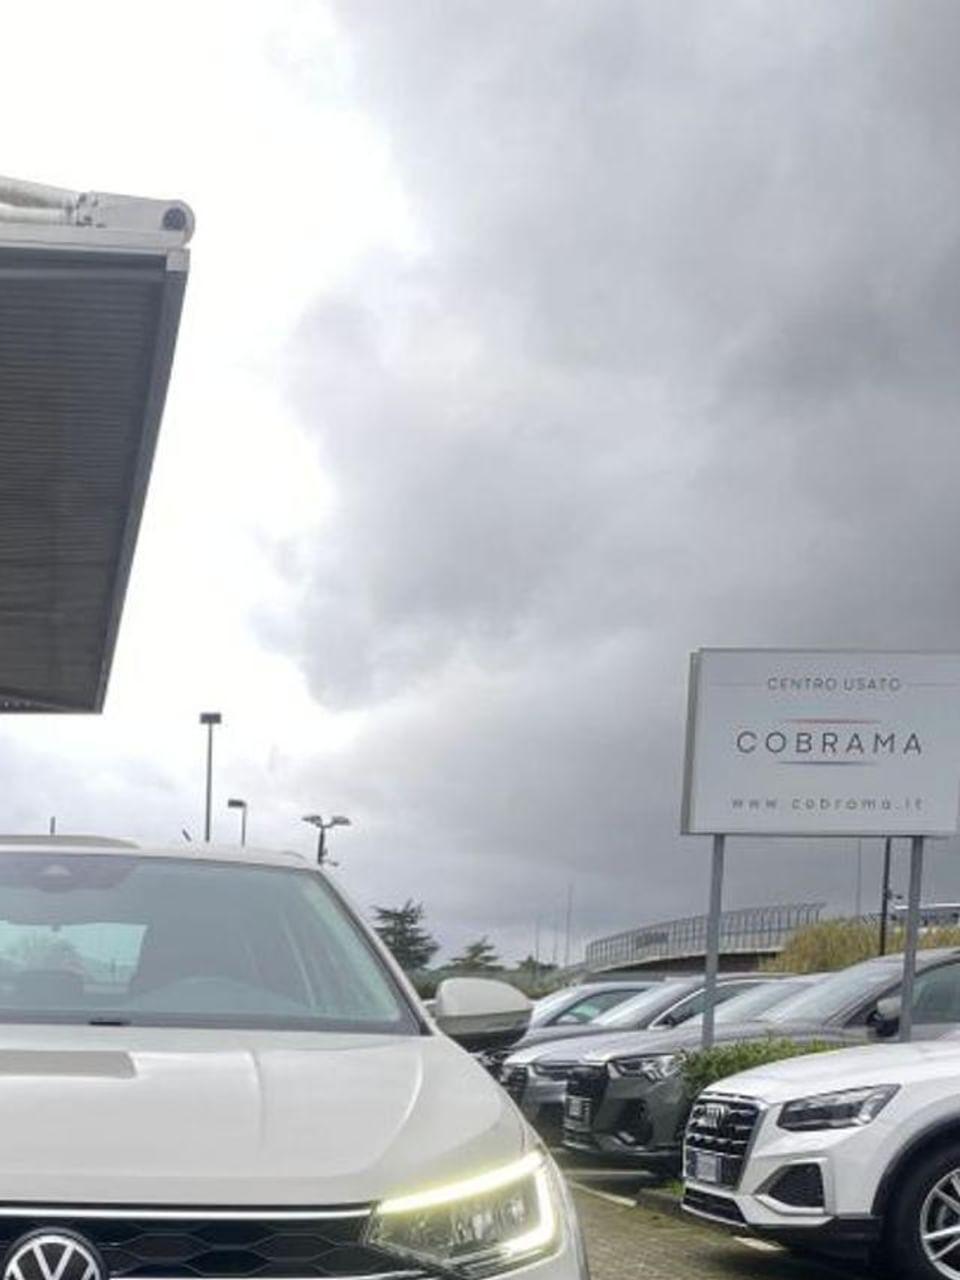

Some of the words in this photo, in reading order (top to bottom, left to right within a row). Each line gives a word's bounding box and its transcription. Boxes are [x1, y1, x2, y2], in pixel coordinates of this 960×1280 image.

[767, 677, 837, 691] CENTRO
[843, 677, 901, 692] USATO
[736, 731, 922, 754] COBRAMA
